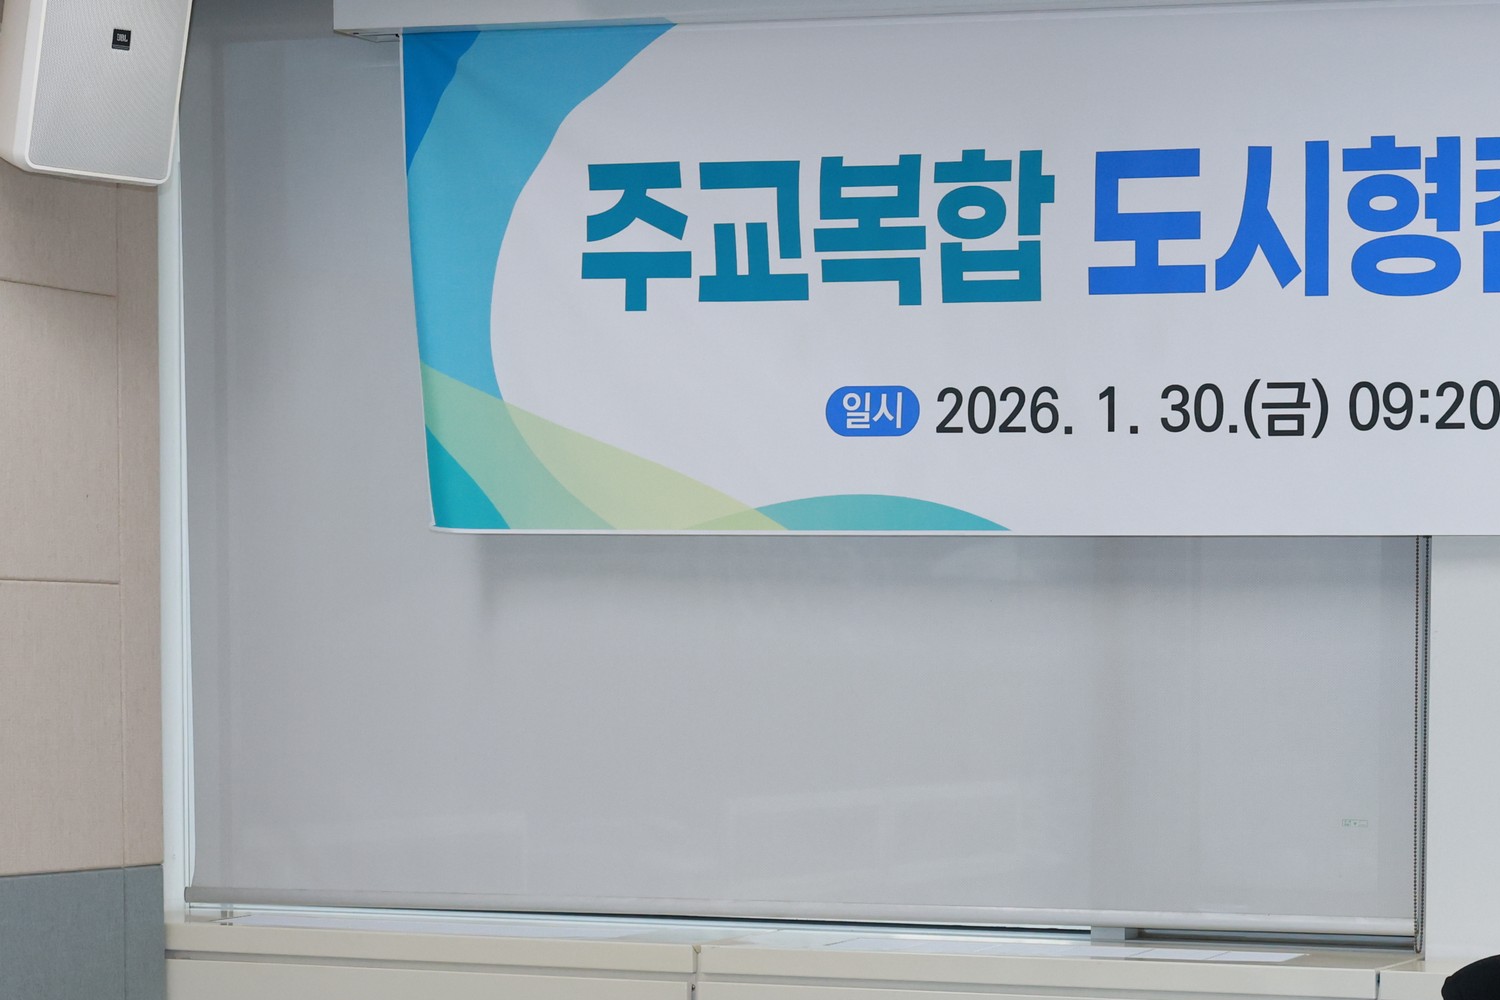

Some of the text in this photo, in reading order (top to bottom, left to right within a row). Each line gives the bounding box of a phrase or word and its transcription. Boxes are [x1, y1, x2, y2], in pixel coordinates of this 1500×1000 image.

[116, 33, 128, 42] JBL
[581, 149, 1055, 311] 주교복합
[841, 378, 1500, 439] 일시 2026. 1. 30.(금) 09:20
